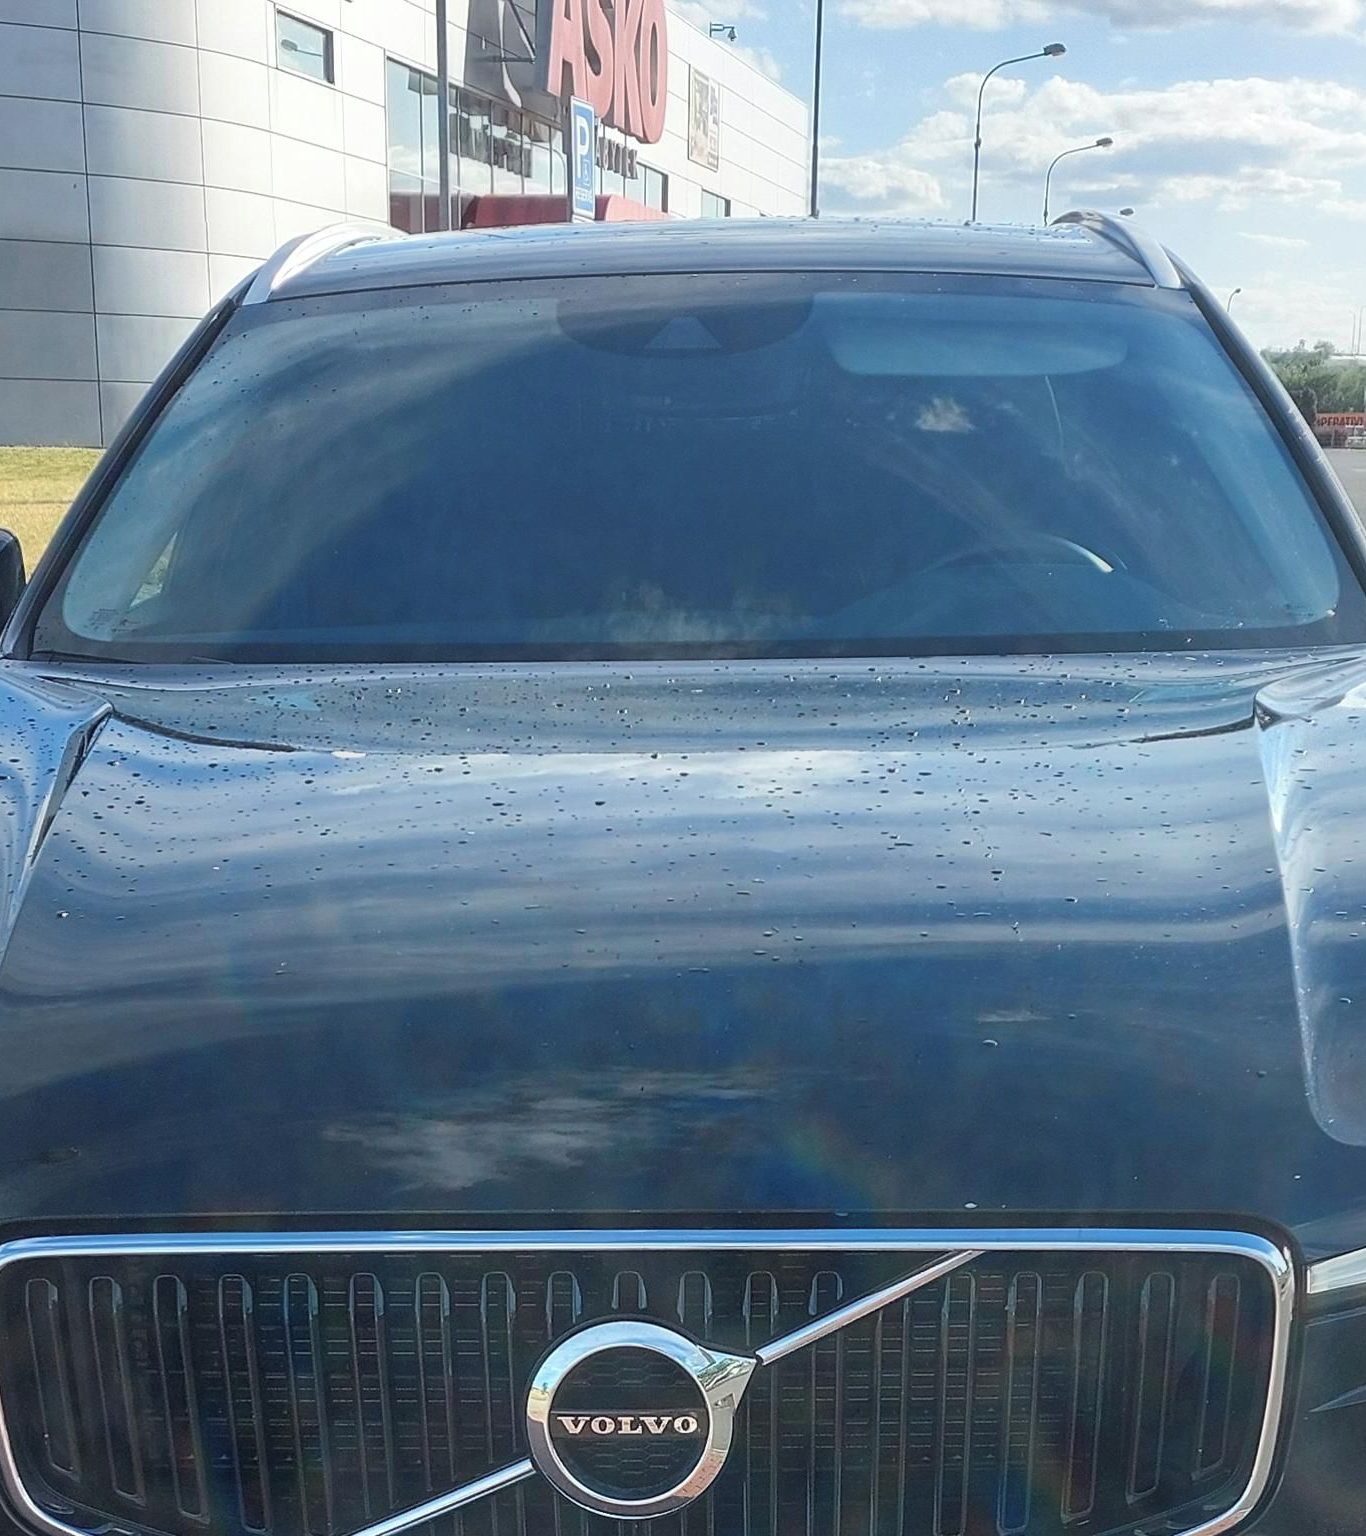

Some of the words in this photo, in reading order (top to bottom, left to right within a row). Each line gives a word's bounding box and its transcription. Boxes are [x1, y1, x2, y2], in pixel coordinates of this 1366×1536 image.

[547, 0, 669, 144] ASKO
[576, 114, 589, 178] P
[556, 1416, 698, 1435] VOLVO
